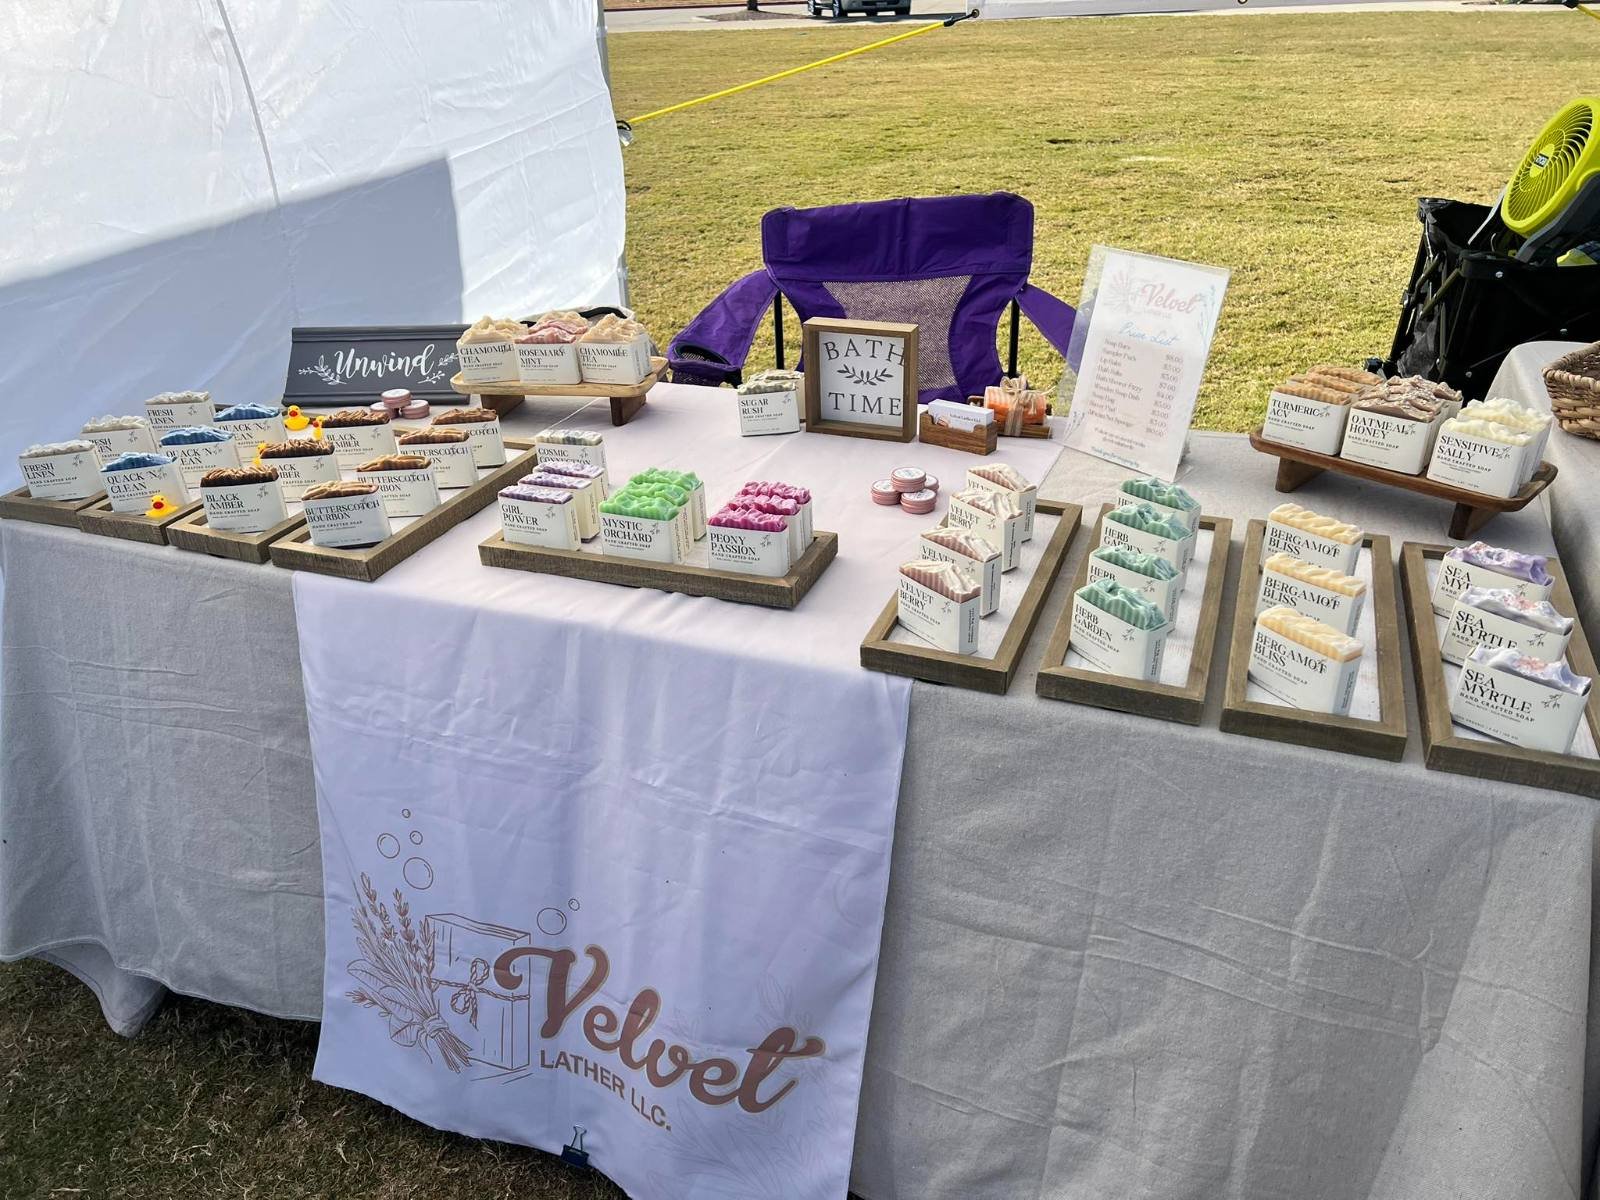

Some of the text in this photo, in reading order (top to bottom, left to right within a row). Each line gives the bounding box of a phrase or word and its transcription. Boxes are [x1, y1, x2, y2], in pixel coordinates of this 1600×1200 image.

[1142, 283, 1202, 313] Velvet
[462, 356, 480, 364] TEA
[520, 349, 566, 357] ROSEMARY
[580, 347, 628, 357] CHAMOMILE
[581, 356, 597, 364] TEA
[824, 338, 904, 366] BATH
[334, 344, 434, 378] Unwind
[521, 357, 541, 366] MINT
[741, 398, 768, 406] SUGAR
[828, 392, 902, 416] TIME
[1272, 399, 1320, 416] TURMERIC
[1270, 408, 1290, 418] ACV
[1350, 424, 1389, 439] HONEY
[1352, 414, 1406, 434] OATMEAL
[538, 448, 568, 457] COSMIC
[1438, 446, 1475, 461] SALLY
[1441, 435, 1500, 456] SENSITIVE
[24, 463, 55, 472] FRESH
[26, 471, 55, 480] LINEN
[107, 470, 159, 485] QUACK 'N
[358, 474, 430, 484] BUTTERSCOTCH
[110, 482, 148, 494] CLEAN
[379, 484, 401, 492] RBON
[205, 494, 240, 503] BLACK
[210, 501, 244, 510] AMBER
[305, 500, 380, 515] BUTTERSCOTCH
[502, 504, 522, 514] GIRL
[950, 504, 979, 524] VELVET
[307, 513, 350, 523] BOURBON
[503, 512, 538, 526] POWER
[602, 518, 642, 531] MYSTIC
[950, 512, 973, 529] BERRY
[604, 529, 652, 543] ORCHARD
[710, 533, 746, 545] PEONY
[1105, 526, 1128, 542] HERB
[1270, 527, 1340, 557] BERGAMOT
[711, 542, 756, 555] PASSION
[1269, 537, 1300, 556] BLISS
[1446, 565, 1470, 582] SEA
[900, 579, 934, 604] VELVET
[1263, 587, 1297, 607] BLISS
[1265, 577, 1340, 610] BERGAMOT
[900, 590, 926, 610] BERRY
[1076, 604, 1098, 624] HERB
[1456, 610, 1484, 629] SEA
[1074, 614, 1112, 642] GARDEN
[1454, 621, 1517, 648] MYRTLE
[1255, 642, 1285, 667] BLISS
[1256, 632, 1327, 674] BERGAMOT
[1465, 669, 1495, 689] SEA
[1462, 680, 1532, 714] MYRTLE
[1460, 692, 1478, 702] HAND
[1481, 700, 1513, 715] CRAFTED
[1516, 713, 1535, 722] SOAP
[494, 944, 825, 1114] Velvet
[540, 1050, 671, 1132] LATHER LLC.
